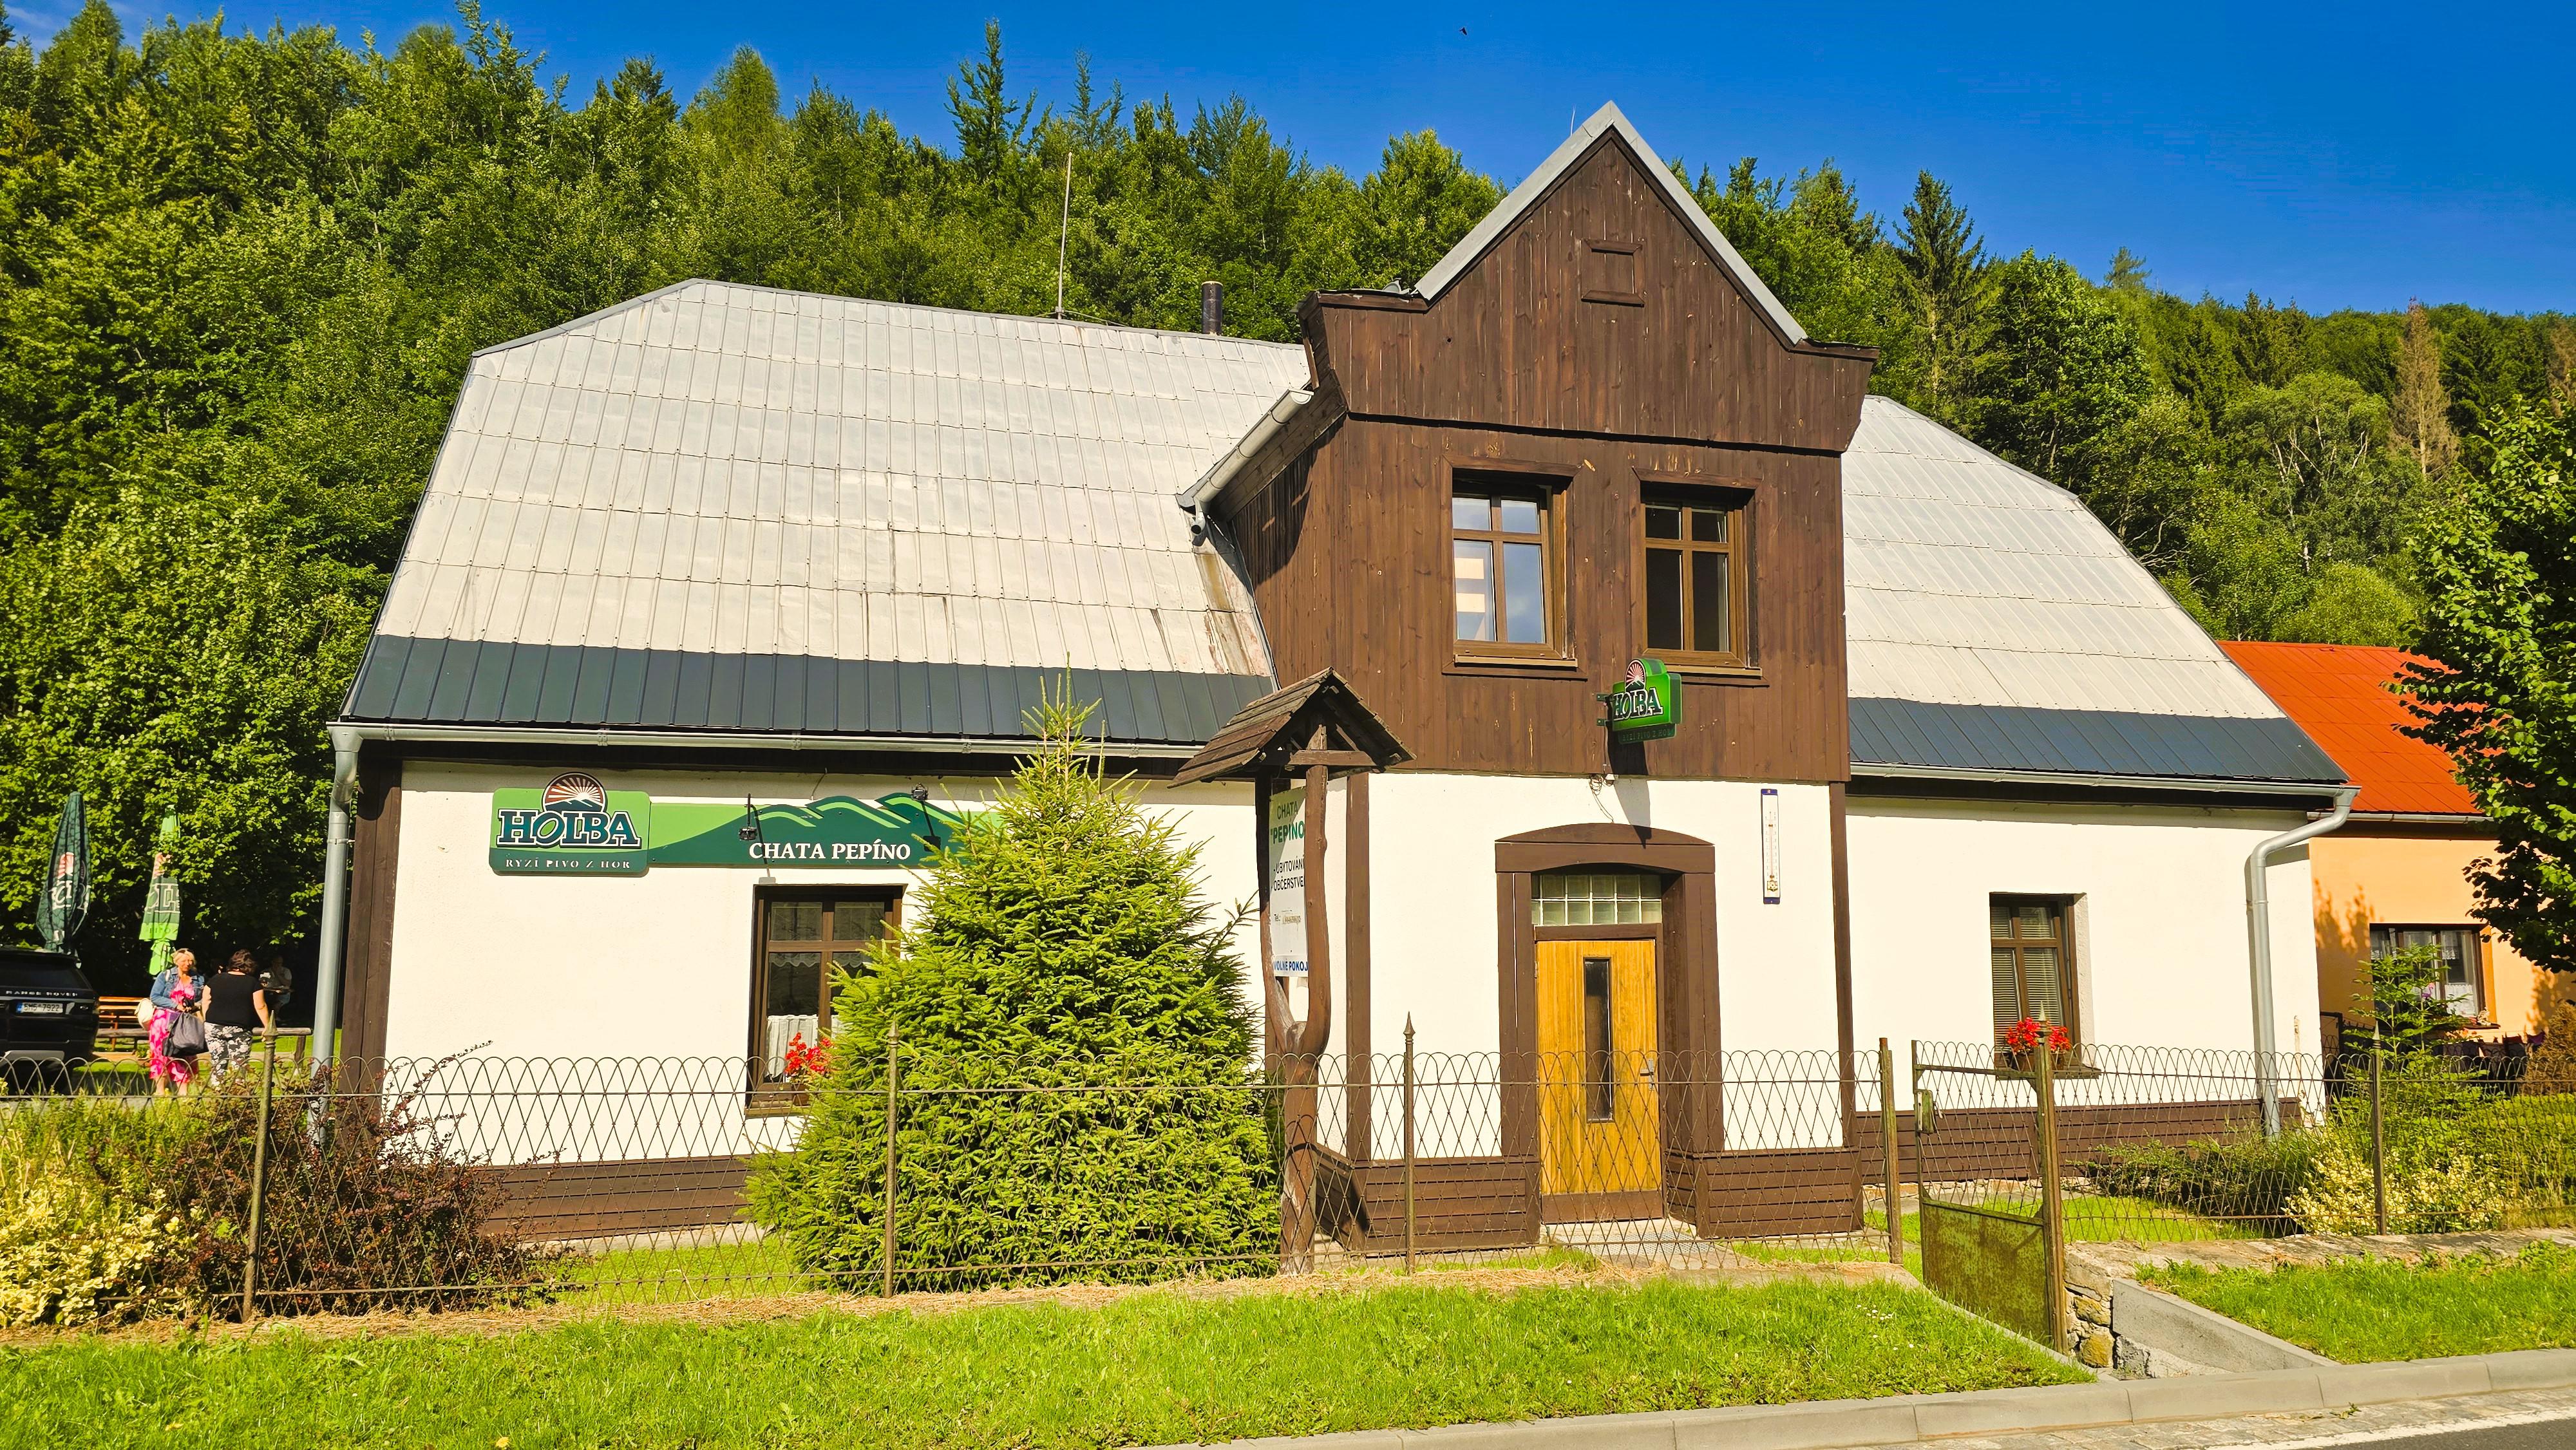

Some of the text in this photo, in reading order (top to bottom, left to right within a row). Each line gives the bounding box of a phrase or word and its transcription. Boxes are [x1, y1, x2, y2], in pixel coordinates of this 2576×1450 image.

[1613, 687, 1664, 721] HOLBA
[1277, 801, 1298, 820] CHATA
[497, 809, 641, 849] HOLBA
[749, 838, 911, 860] CHATA PEPÍNO
[506, 856, 539, 868] RYZÍ
[546, 860, 579, 868] PIVO
[1273, 876, 1304, 890] OBČERSTVE
[1289, 961, 1309, 971] POKOJ
